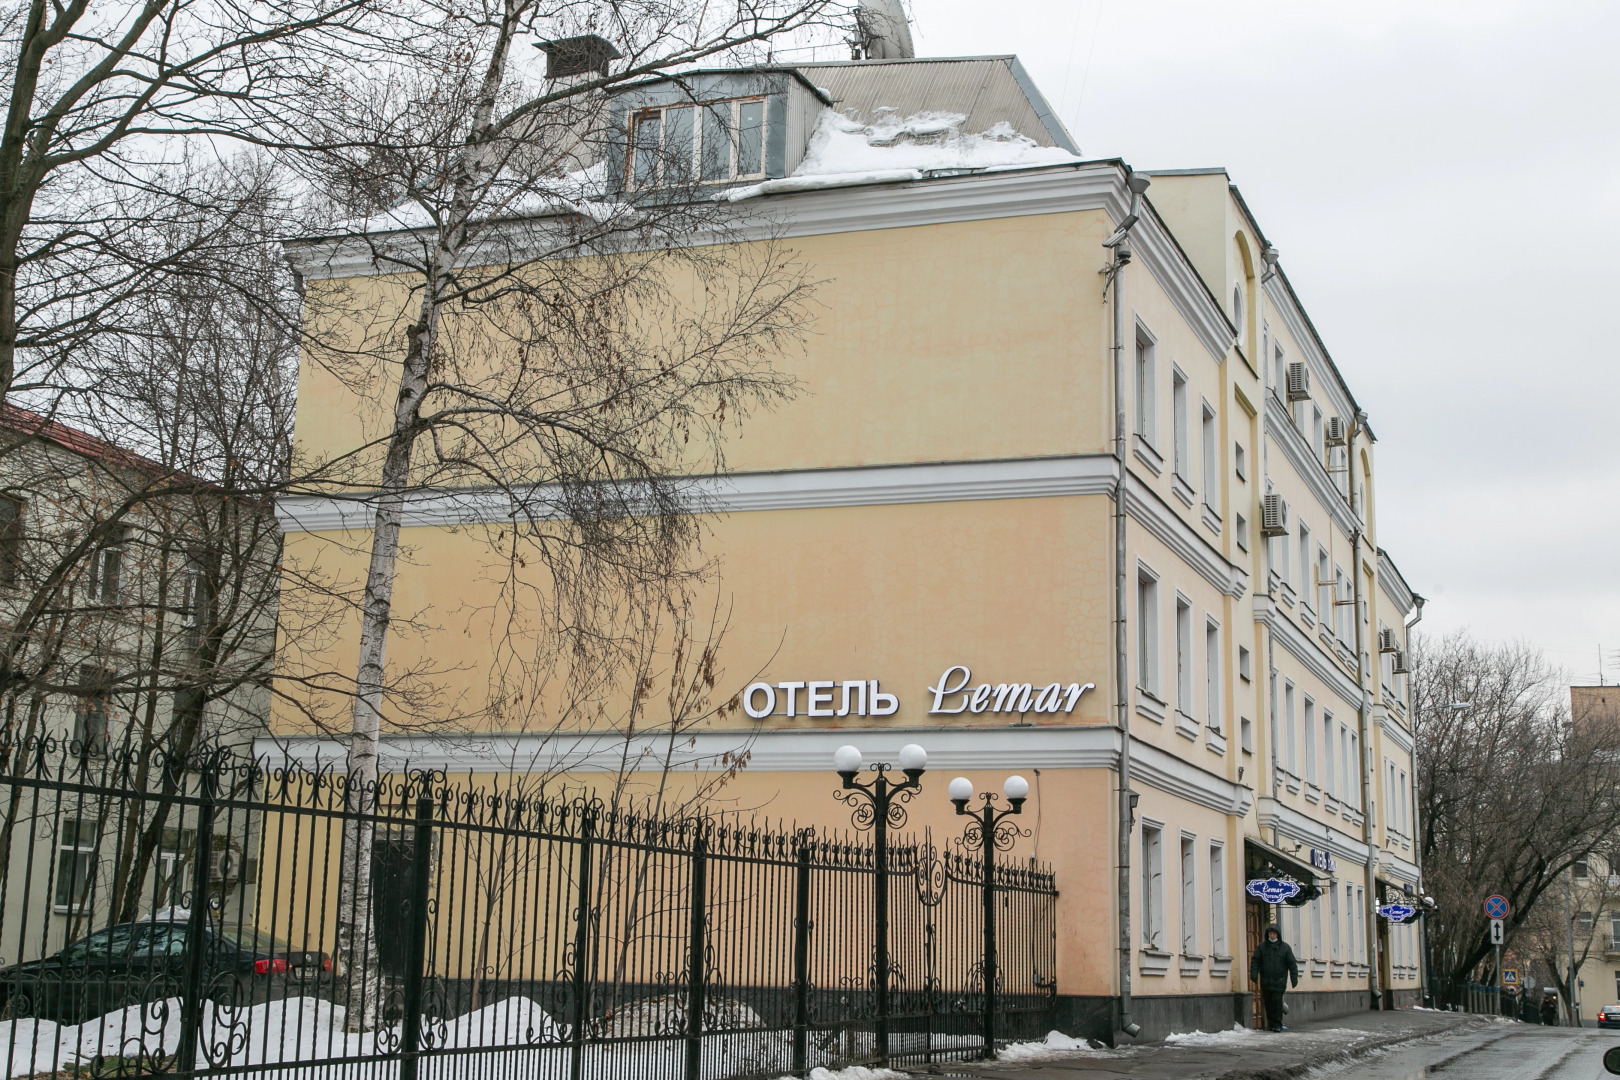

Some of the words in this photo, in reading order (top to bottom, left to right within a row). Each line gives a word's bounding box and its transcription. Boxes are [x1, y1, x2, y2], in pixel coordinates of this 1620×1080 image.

[743, 680, 900, 718] ОТЕЛЬ
[927, 665, 1096, 714] Lemar
[1262, 883, 1284, 893] Lemar
